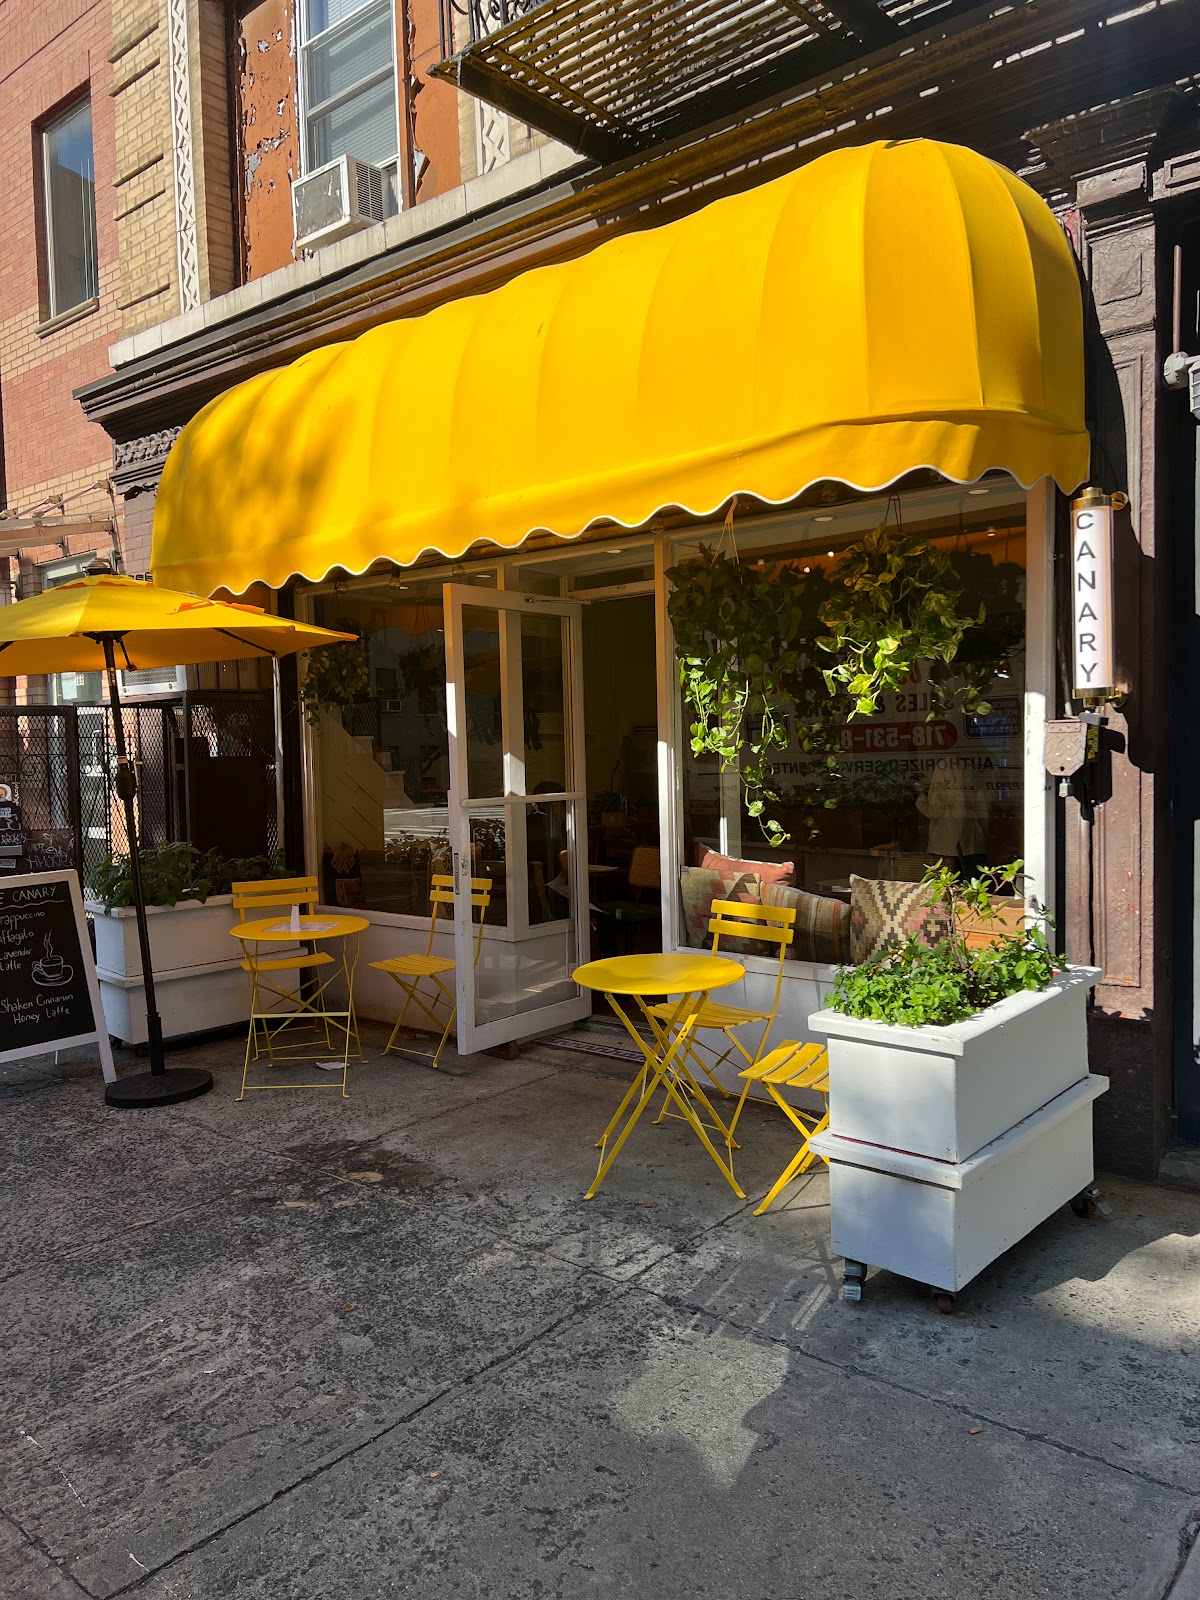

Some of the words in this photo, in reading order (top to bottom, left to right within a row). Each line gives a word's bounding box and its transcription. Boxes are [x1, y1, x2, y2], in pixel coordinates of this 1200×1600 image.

[1076, 512, 1098, 683] CANARY
[12, 885, 57, 903] CANARY
[0, 996, 34, 1014] Shaken
[36, 993, 74, 1007] Cinnamon
[13, 1012, 40, 1025] Honey
